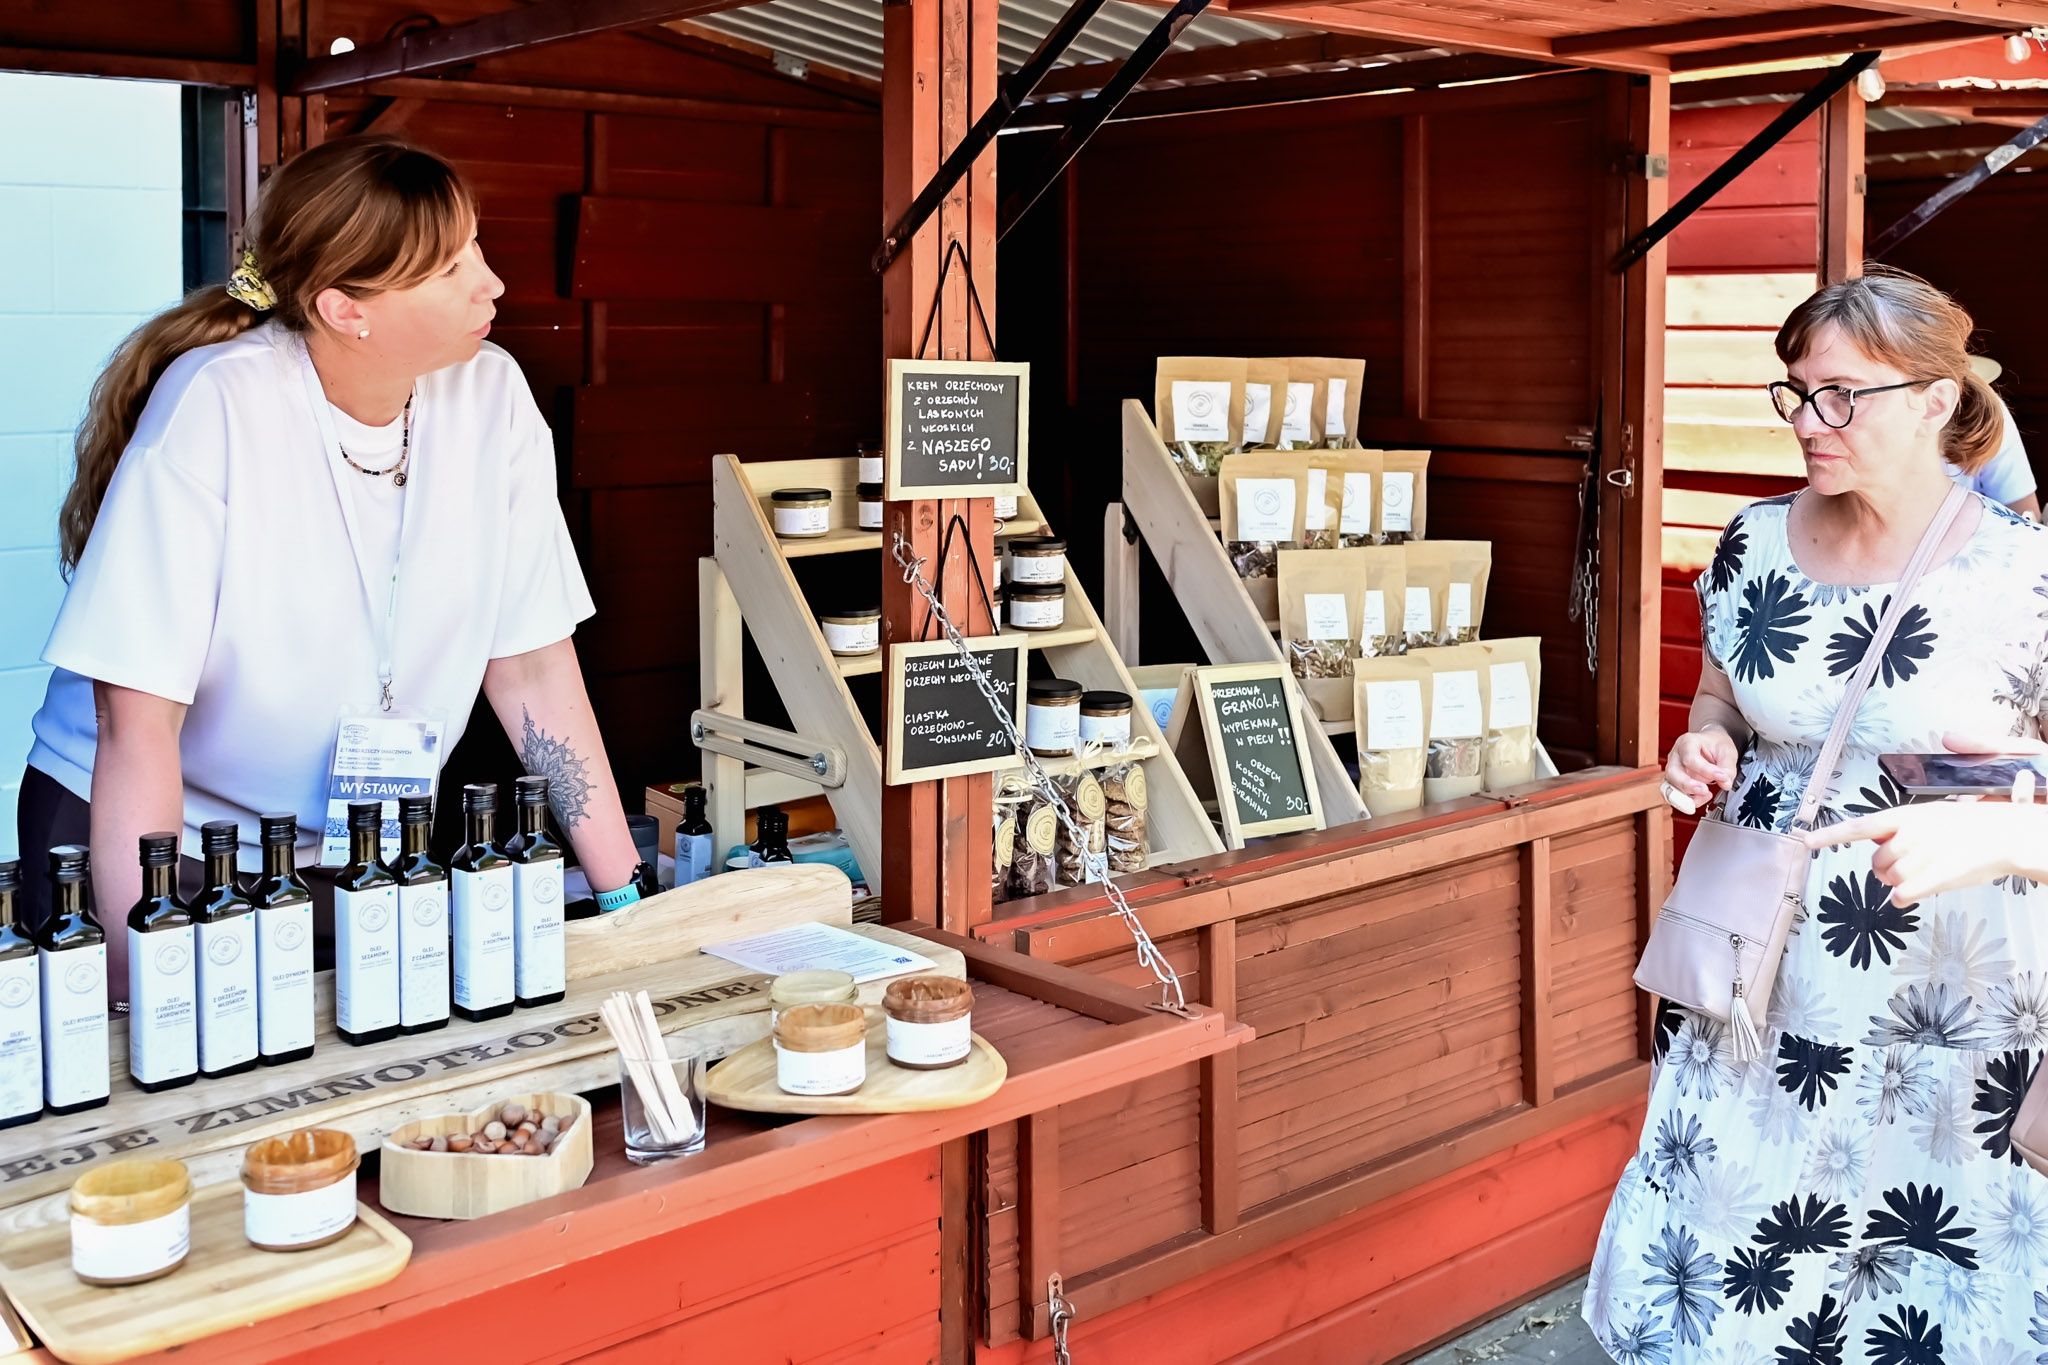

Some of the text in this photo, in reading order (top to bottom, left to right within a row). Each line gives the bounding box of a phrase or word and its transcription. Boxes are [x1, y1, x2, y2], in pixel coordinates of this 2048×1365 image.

[907, 381, 1004, 394] KREM ORZECHOWY
[913, 392, 979, 406] Z ORZECHÓW
[918, 409, 984, 419] LASKOWYCH
[922, 438, 991, 455] NASZEGO
[905, 660, 945, 672] ORZECHY
[906, 675, 946, 688] ORZECHY
[1211, 685, 1260, 698] ORZECHOWA
[1221, 693, 1280, 716] GRANOLA
[905, 710, 949, 724] CIASTKA
[1222, 718, 1278, 733] WYPIEKANA
[1247, 734, 1274, 746] PIECU
[1236, 760, 1265, 787] KOKOS
[1250, 759, 1281, 783] ORZECH
[340, 782, 420, 795] WYSTAWCA
[1241, 777, 1271, 805] DAKTYL
[175, 982, 760, 1134] ZIMNOTŁOCONE
